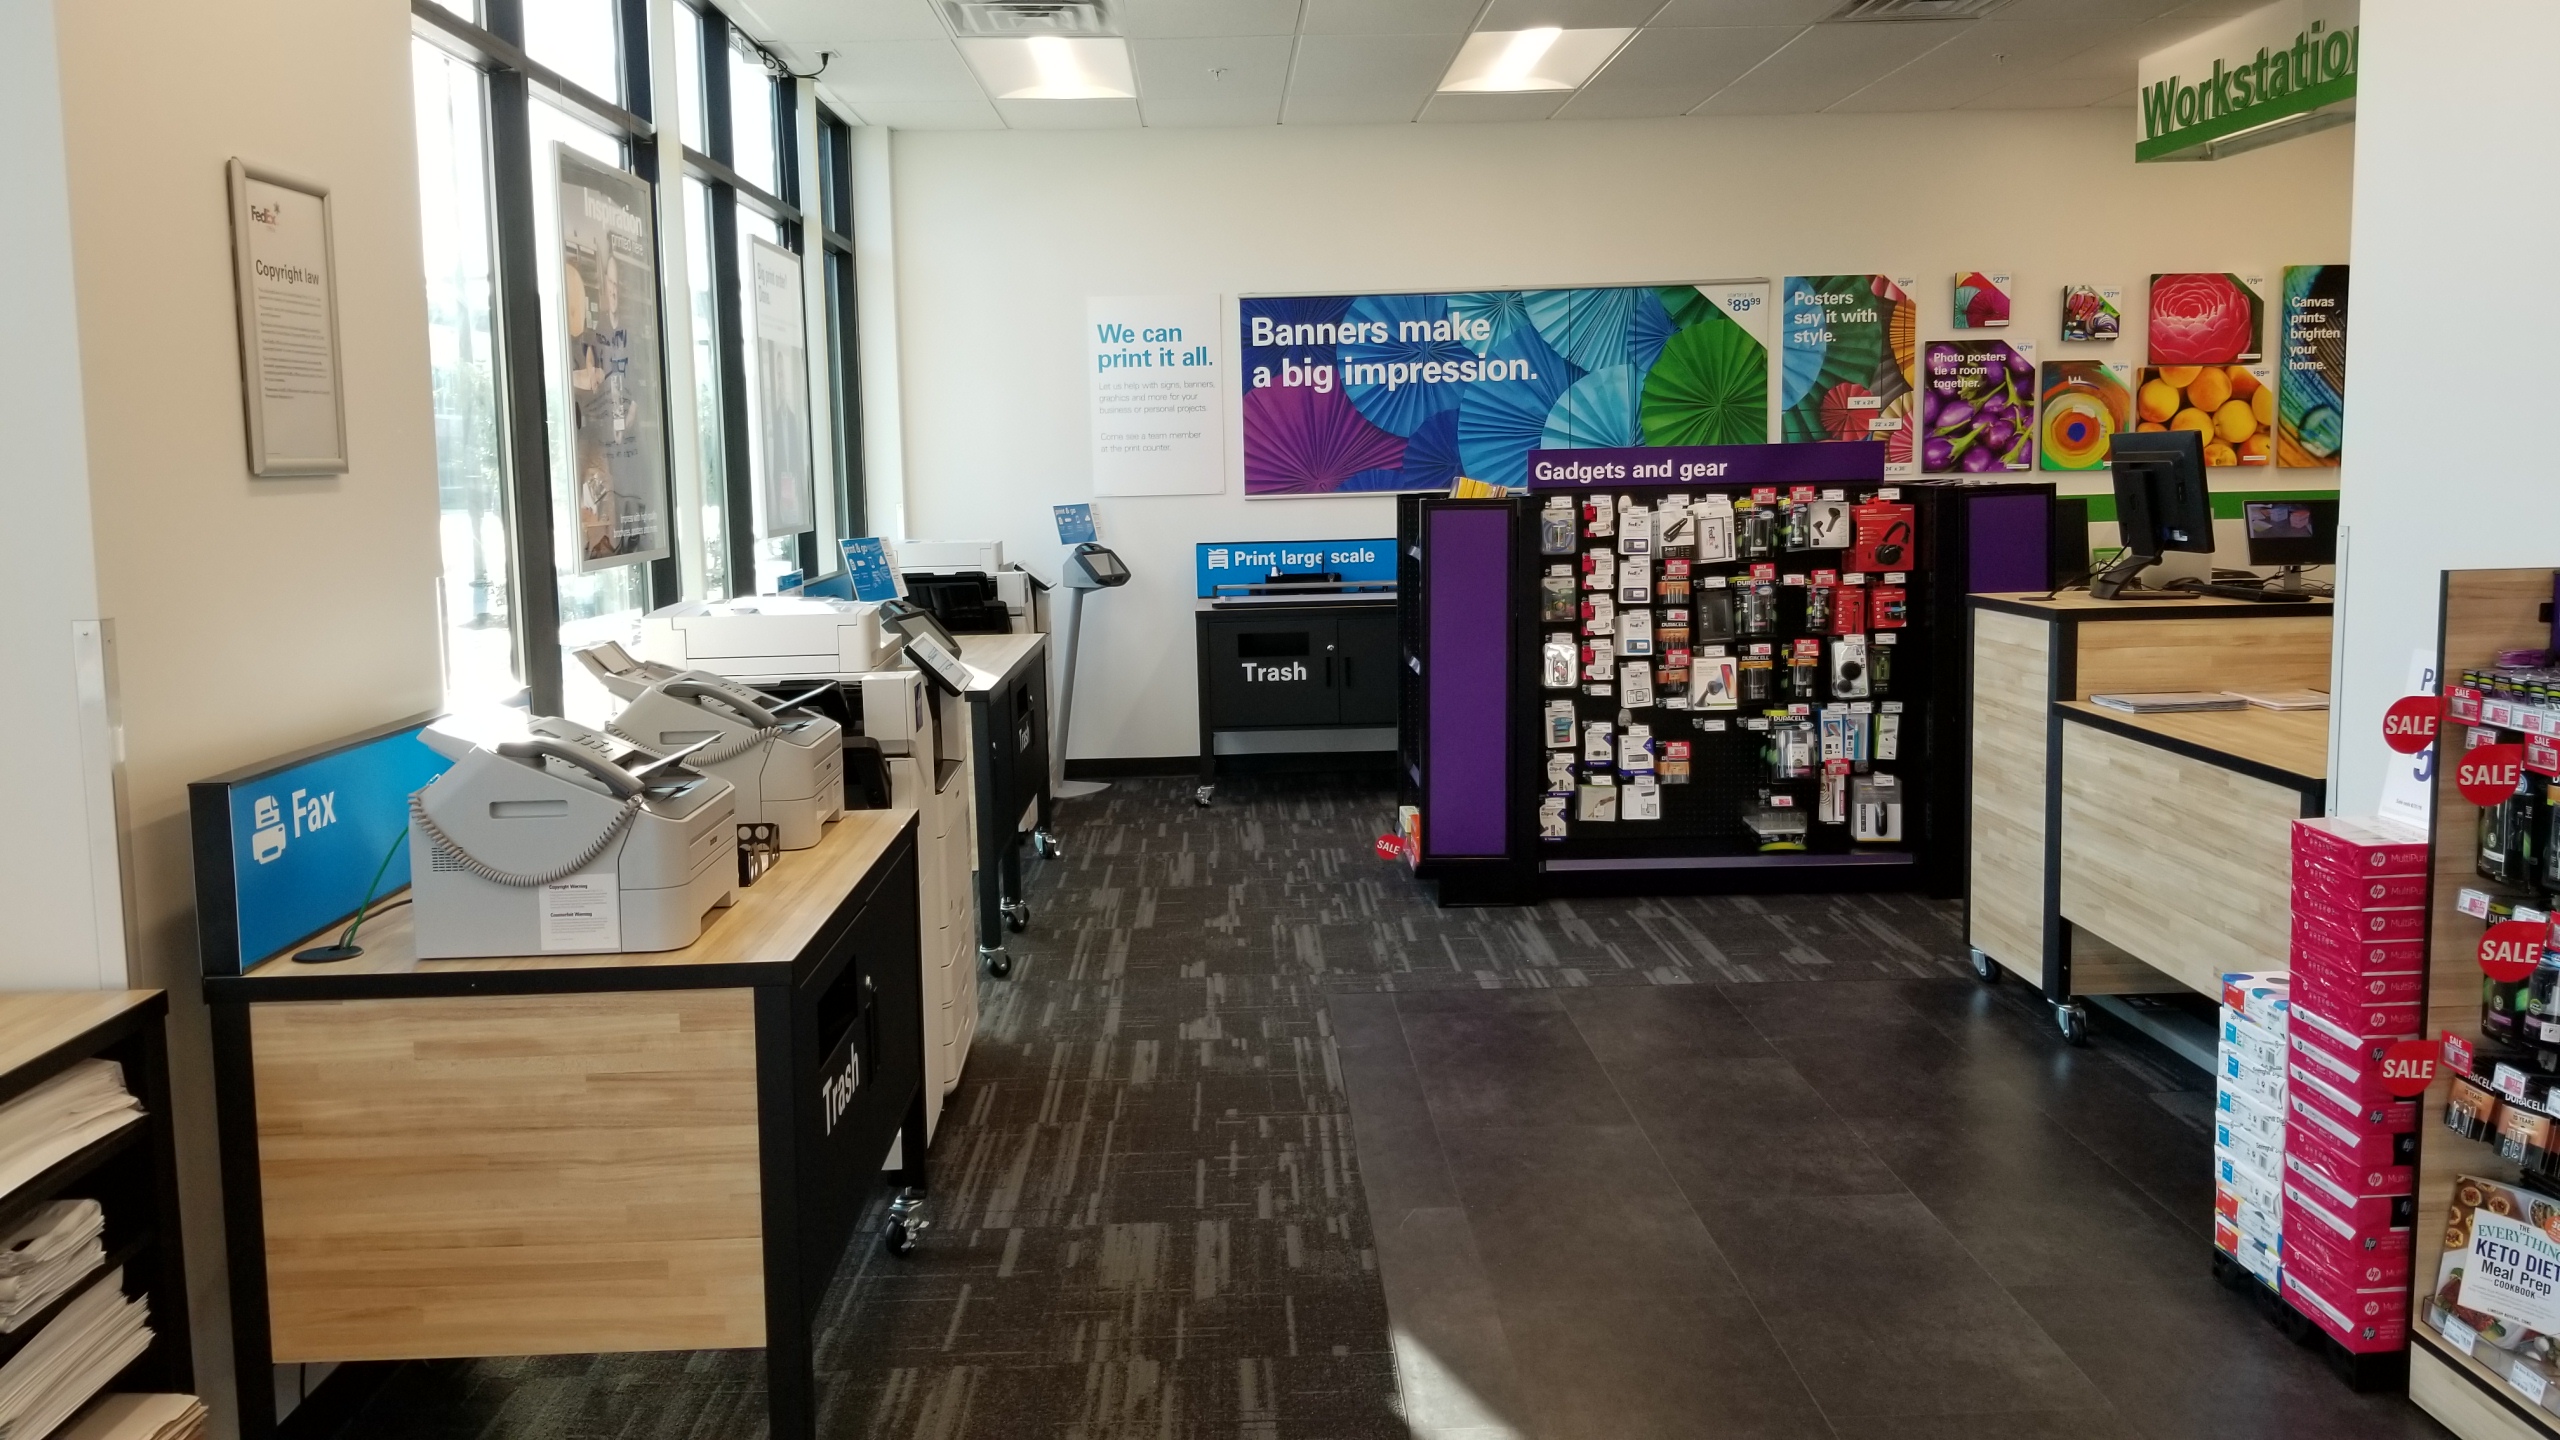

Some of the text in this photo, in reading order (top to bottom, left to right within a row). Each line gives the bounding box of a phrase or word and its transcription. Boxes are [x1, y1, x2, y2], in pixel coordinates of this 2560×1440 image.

[2142, 19, 2359, 139] Workstatio
[251, 205, 277, 226] FedEx
[584, 187, 642, 237] Inspiration
[256, 260, 320, 286] Copyright law
[1794, 291, 1854, 305] Posters
[2291, 297, 2334, 308] Canvas
[1794, 309, 1877, 325] say it with
[2291, 312, 2326, 326] prints
[1097, 324, 1182, 343] We can
[1251, 311, 1490, 346] Banners make
[2291, 328, 2340, 342] brighten
[1794, 329, 1836, 346] style.
[2290, 345, 2317, 357] your
[1098, 346, 1213, 373] print it all.
[1934, 352, 2006, 366] Photo posters
[2289, 360, 2326, 370] home.
[1252, 354, 1537, 393] a big impression.
[1934, 366, 1947, 375] tie
[1959, 366, 1987, 375] room
[1124, 382, 1139, 390] help
[1933, 379, 1980, 391] together.
[1099, 393, 1129, 403] graphics
[1181, 394, 1198, 402] your
[1099, 406, 1132, 414] business
[1144, 405, 1175, 414] personal
[1169, 431, 1201, 439] member
[1125, 444, 1140, 453] print
[1535, 459, 1728, 483] Gadgets and gear
[1234, 548, 1375, 568] Print large scale
[1241, 661, 1307, 682] Trash
[2454, 688, 2470, 699] SALE
[2386, 715, 2435, 735] SALE
[2534, 736, 2550, 747] SALE
[2459, 764, 2517, 786] SALE
[292, 787, 337, 839] Fax
[1377, 840, 1400, 855] SALE
[2370, 853, 2386, 867] hp
[2370, 885, 2385, 899] hp
[2370, 917, 2385, 931] hp
[2370, 949, 2385, 963] hp
[2481, 940, 2540, 964] SALE
[2370, 981, 2385, 995] hp
[2370, 1013, 2385, 1027] hp
[2449, 1035, 2462, 1048] SALE
[2372, 1048, 2383, 1061] hp
[2382, 1059, 2433, 1079] SALE
[821, 1041, 861, 1137] Trash
[2370, 1111, 2382, 1124] hp
[2519, 1116, 2535, 1127] YEARS
[2368, 1173, 2382, 1186] hp
[2519, 1225, 2530, 1233] THE
[2364, 1238, 2376, 1251] hp
[2476, 1238, 2560, 1282] KETO DIET
[2366, 1267, 2381, 1281] hp
[2481, 1259, 2551, 1296] Meal Prep
[2494, 1279, 2535, 1299] COOKBOOK
[2364, 1301, 2379, 1315] hp
[2363, 1327, 2375, 1339] hp
